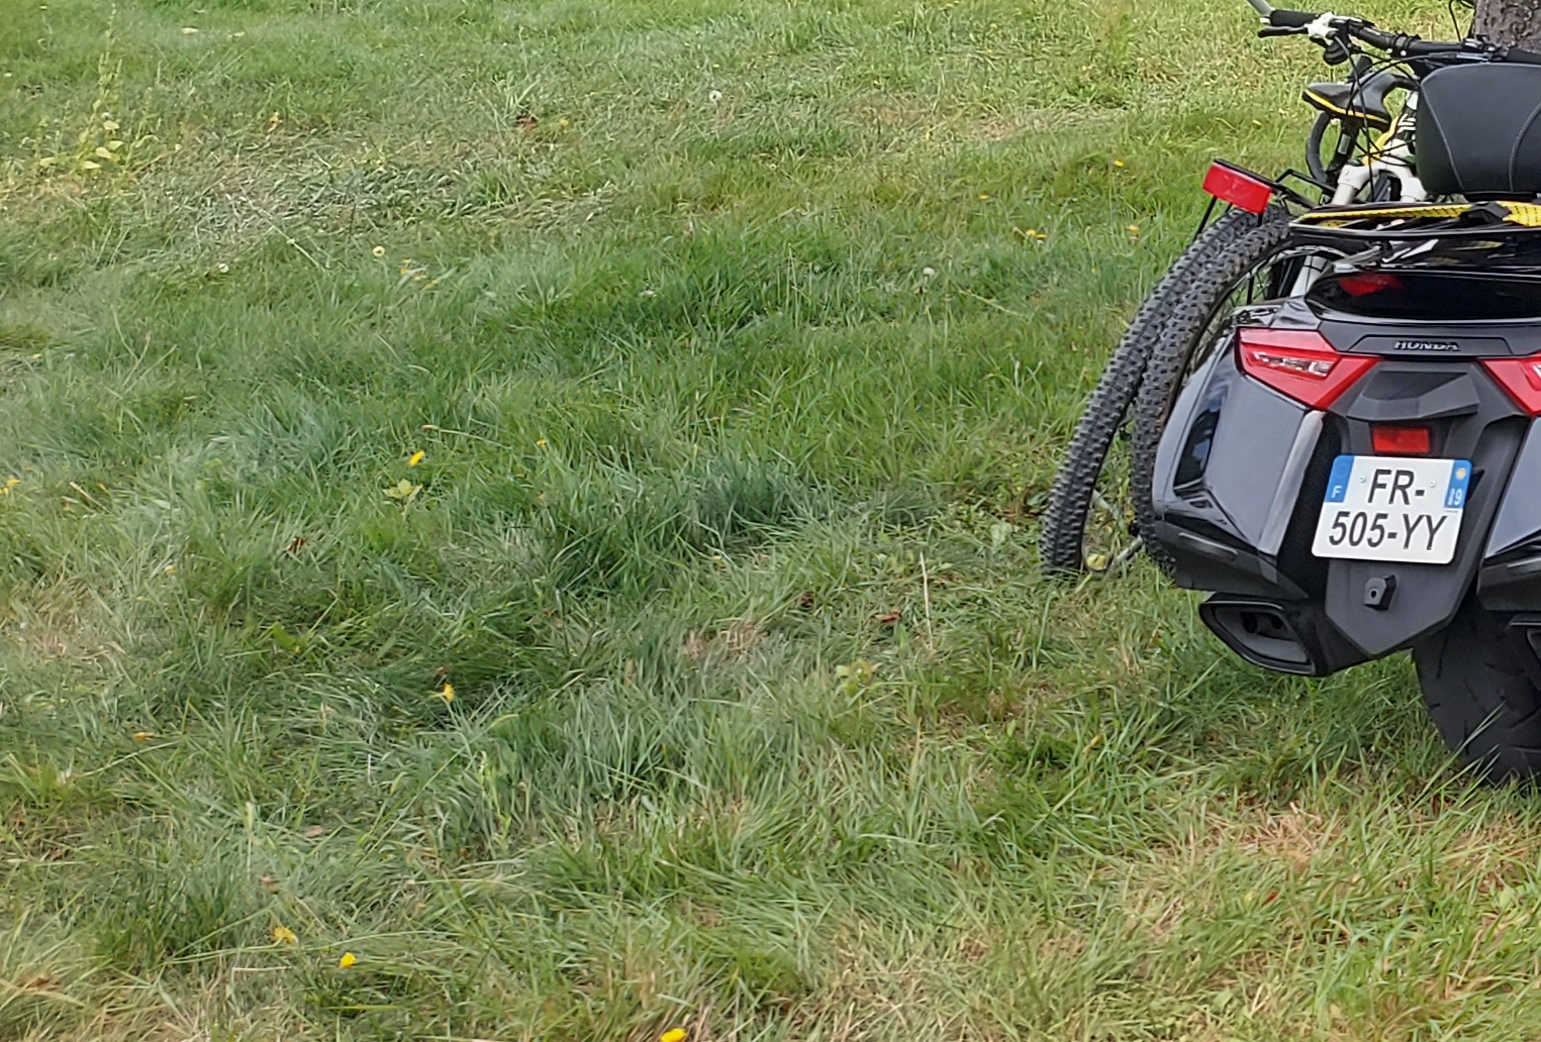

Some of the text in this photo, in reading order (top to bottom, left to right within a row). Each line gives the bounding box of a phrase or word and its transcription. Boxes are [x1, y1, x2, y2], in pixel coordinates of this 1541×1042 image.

[1394, 340, 1461, 351] HONDA
[1331, 485, 1341, 499] F
[1448, 488, 1463, 506] 19
[1328, 511, 1448, 551] 505-YY
